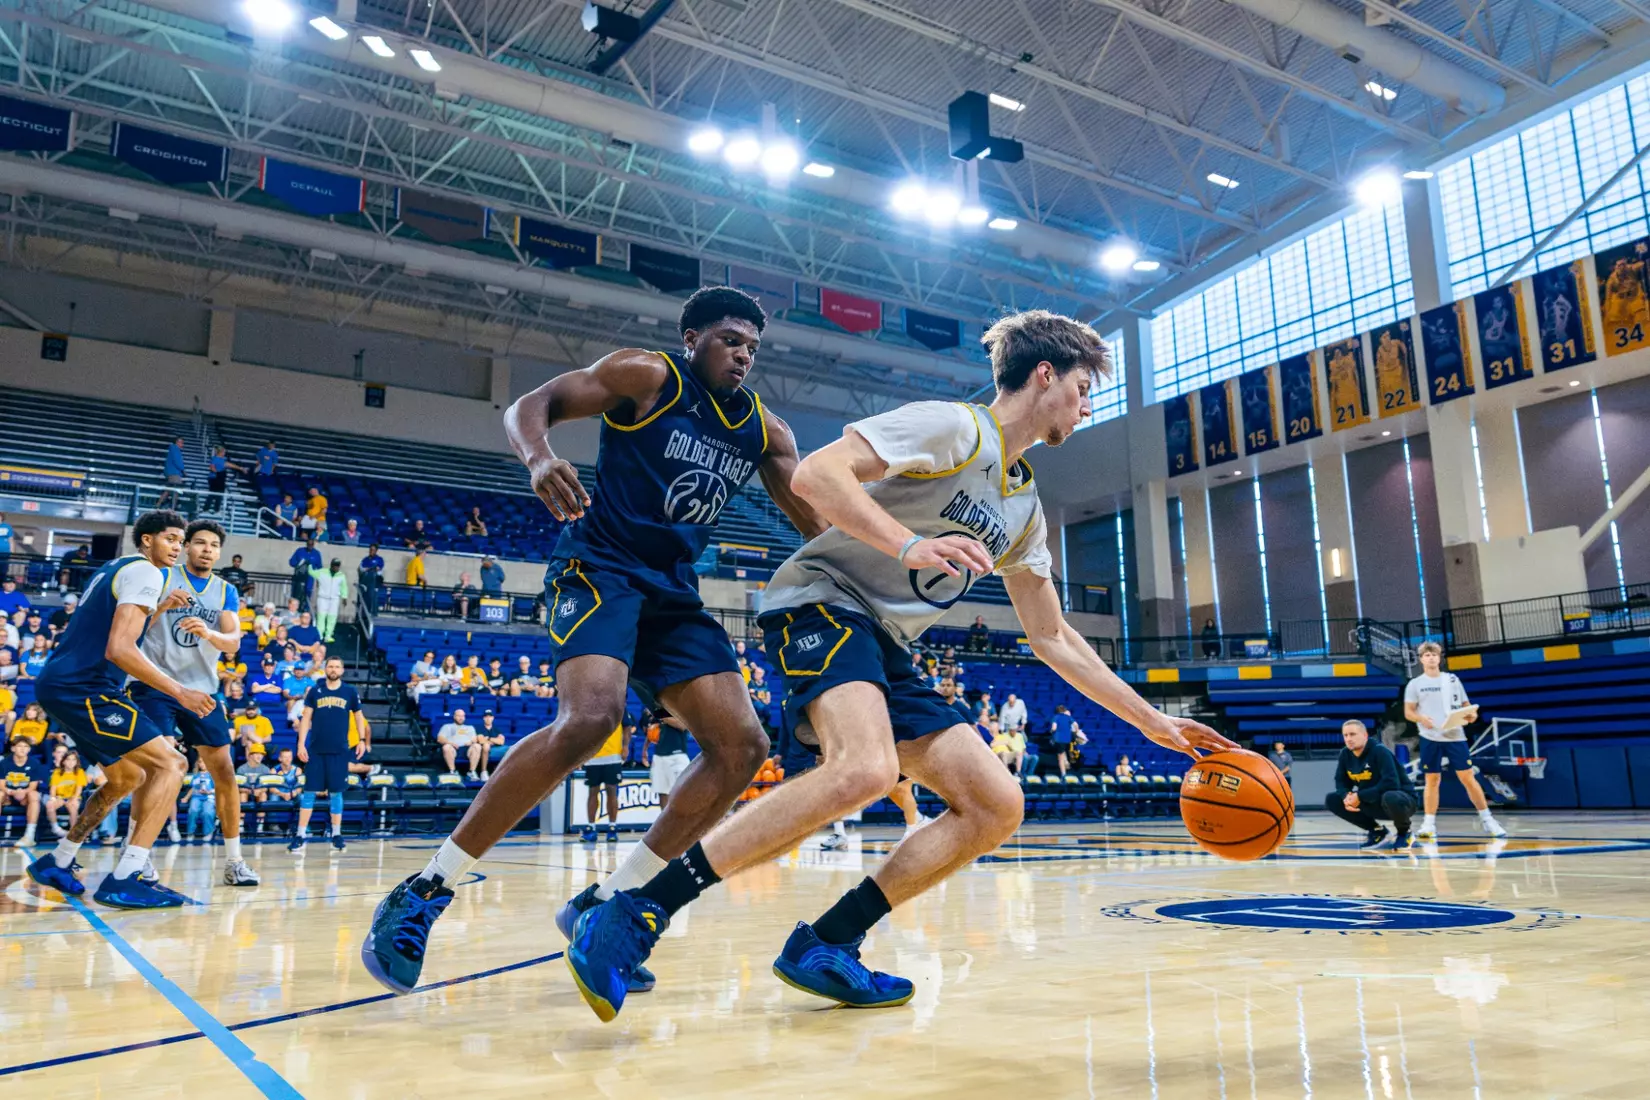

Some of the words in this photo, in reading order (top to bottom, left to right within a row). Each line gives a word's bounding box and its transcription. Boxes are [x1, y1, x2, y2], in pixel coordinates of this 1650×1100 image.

[133, 144, 207, 168] CREIGHTON
[290, 181, 335, 197] DEPAUL
[529, 234, 587, 253] MARQUETTE
[1614, 323, 1645, 348] 34
[1549, 339, 1577, 363] 31
[1489, 356, 1515, 381] 31
[1434, 372, 1460, 397] 24
[1384, 389, 1406, 410] 22
[1335, 403, 1355, 424] 21
[1290, 418, 1310, 437] 20
[663, 429, 718, 470] GOLDEN
[701, 434, 742, 456] MARQUETTE
[1248, 430, 1267, 448] 15
[1209, 442, 1226, 459] 14
[1176, 454, 1185, 469] 3
[940, 489, 991, 537] GOLDEN
[979, 498, 1008, 530] MARQUETTE
[485, 607, 504, 618] 103
[1250, 646, 1265, 655] 106
[1187, 769, 1241, 793] ELITE
